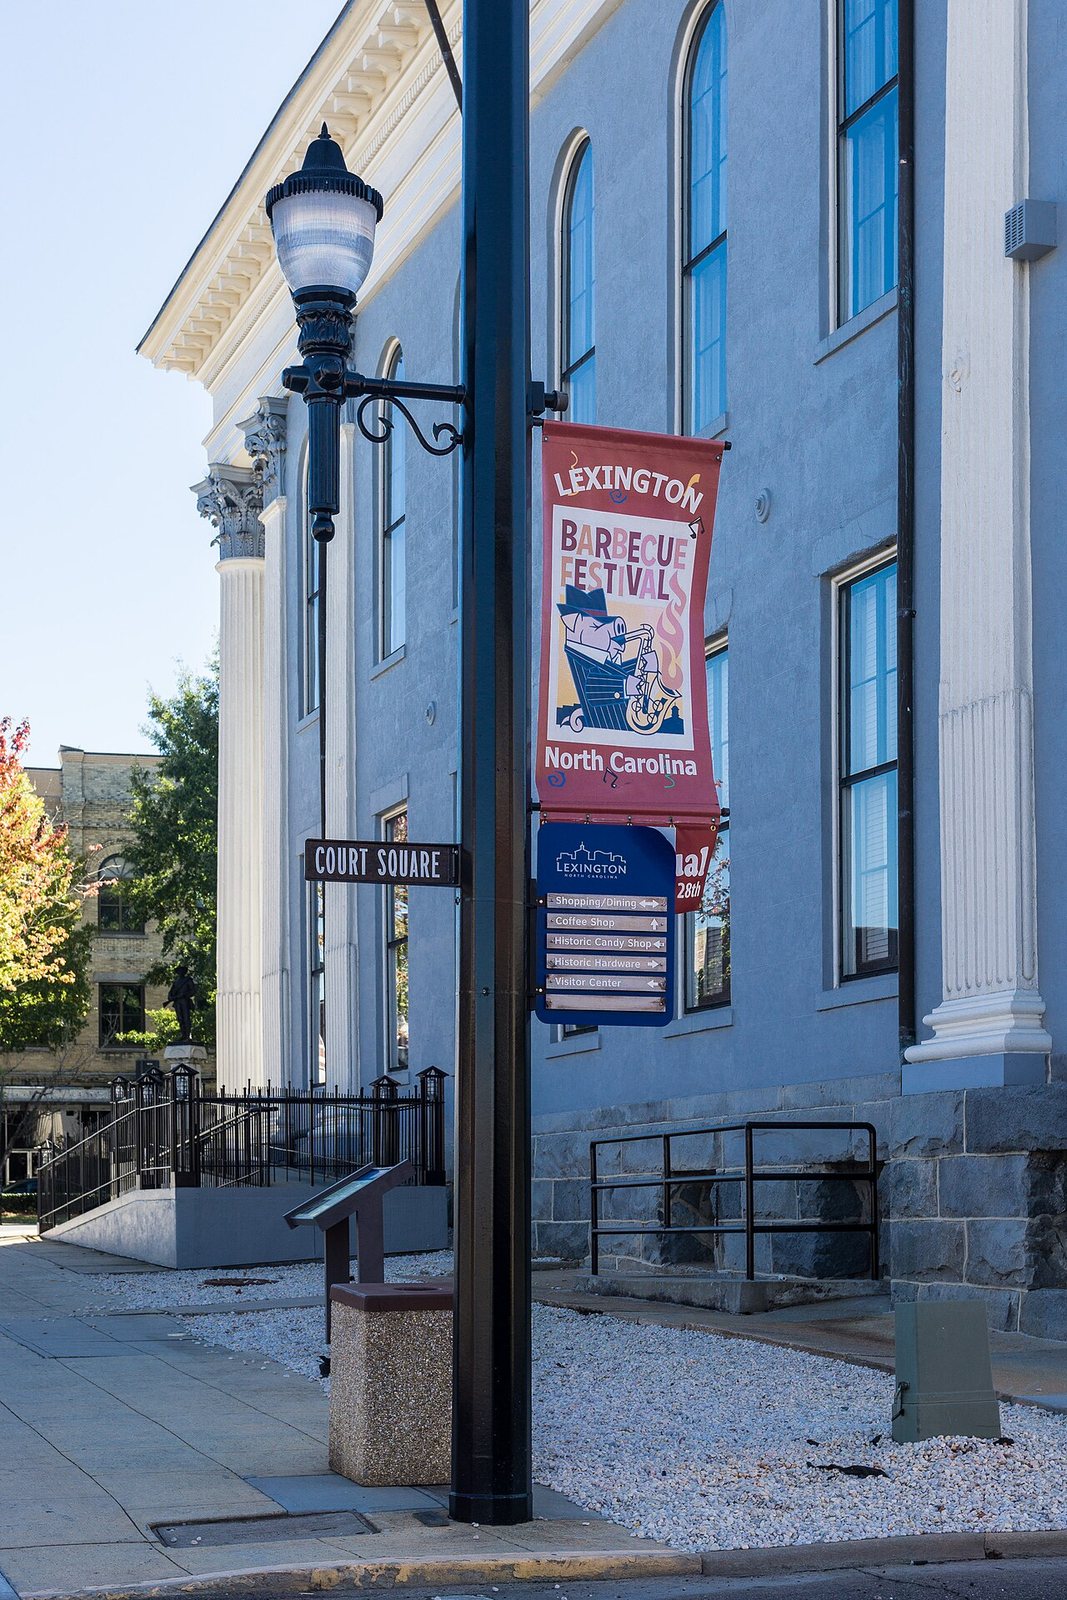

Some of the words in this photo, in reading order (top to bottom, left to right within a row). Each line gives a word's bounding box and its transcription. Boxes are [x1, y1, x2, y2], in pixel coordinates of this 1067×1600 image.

[553, 465, 704, 515] LEXINGTON
[561, 518, 688, 570] BARBECUE
[560, 555, 670, 601] FESTIVAL
[544, 746, 604, 772] North
[609, 751, 698, 776] Carolina
[315, 846, 368, 876] COURT
[377, 848, 441, 878] SQUARE
[556, 861, 627, 875] LEXINGTON
[676, 881, 701, 899] 28th
[555, 896, 637, 909] Shopping/Dining
[555, 916, 587, 926] Coffee
[590, 917, 615, 928] Shop
[554, 936, 592, 946] Historic
[594, 937, 625, 949] Candy
[627, 939, 652, 950] Shop
[554, 957, 592, 967] Historic
[594, 958, 641, 969] Hardware
[555, 977, 586, 987] Visitor
[589, 979, 622, 988] Center
